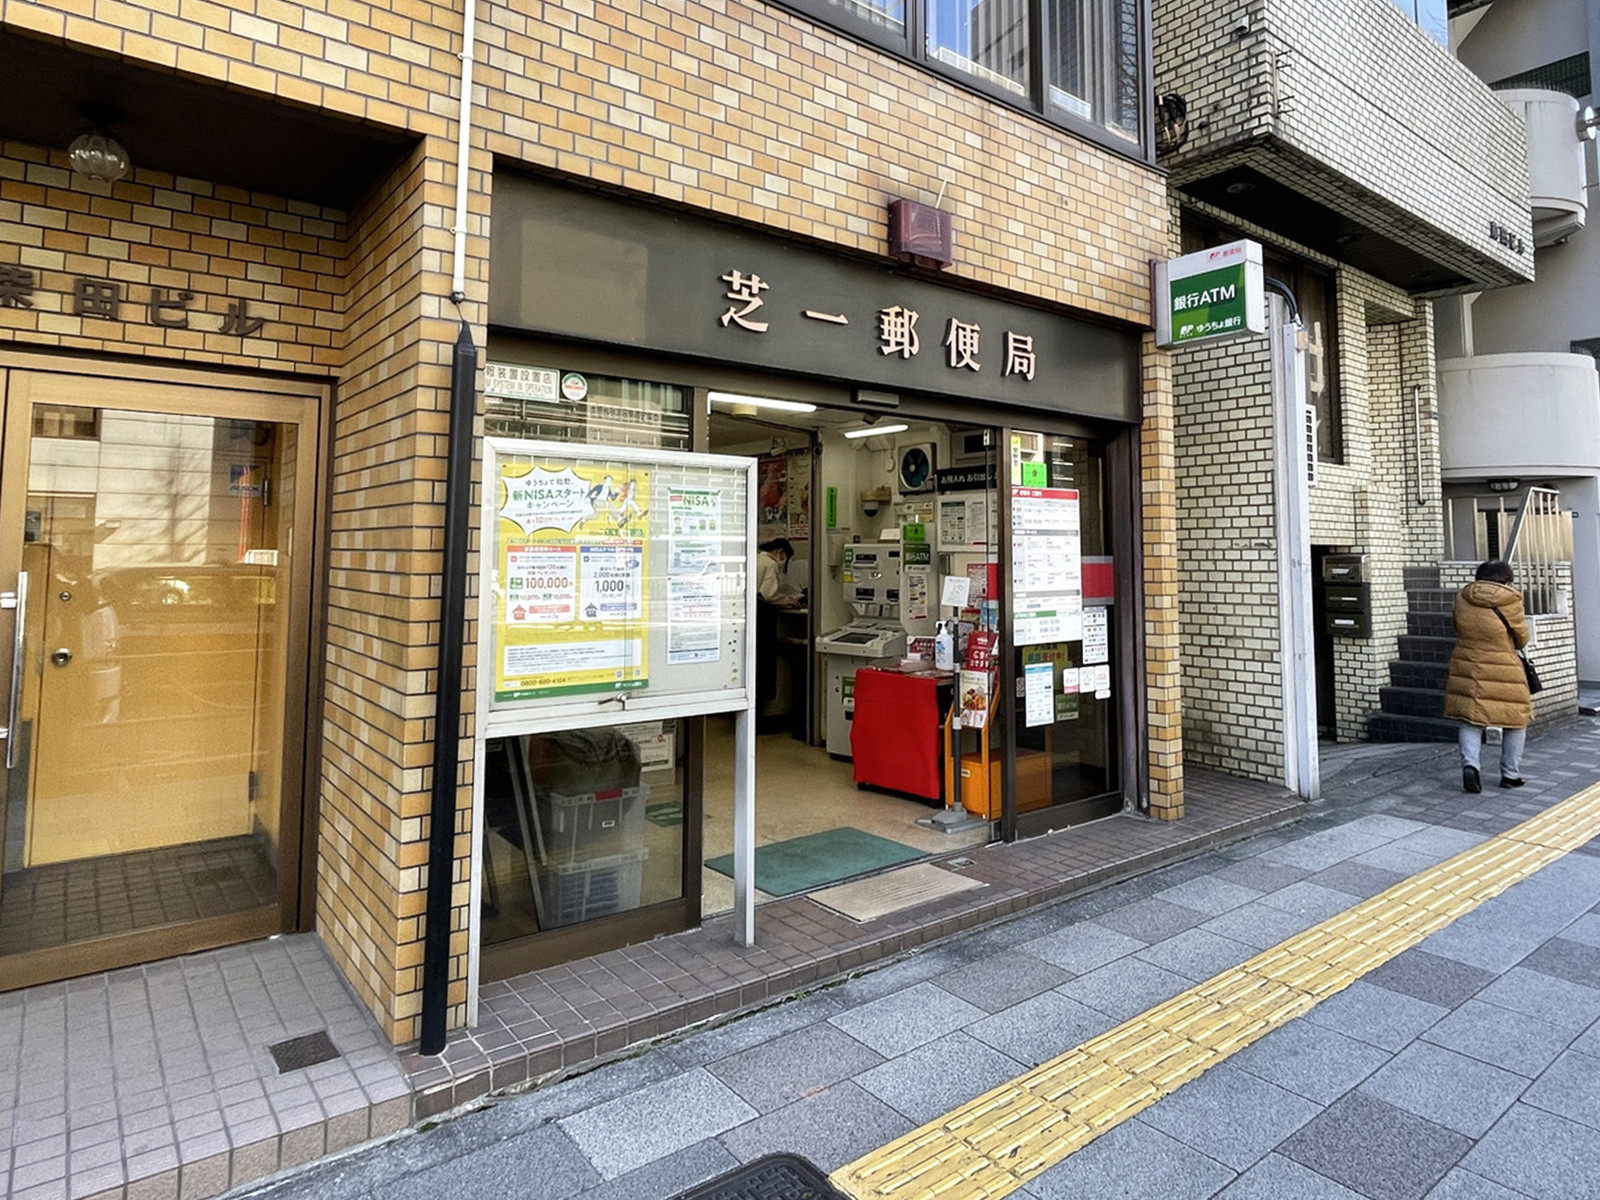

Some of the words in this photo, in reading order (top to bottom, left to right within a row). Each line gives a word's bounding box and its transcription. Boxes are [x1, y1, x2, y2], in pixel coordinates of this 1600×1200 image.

[1174, 284, 1235, 311] 銀行ATM
[721, 269, 1036, 381] 芝一郵便局
[1196, 316, 1241, 333] ゆうちょ銀行
[513, 488, 585, 501] 新NISAスタート
[683, 495, 710, 506] NISA
[527, 501, 574, 509] キャンペーン
